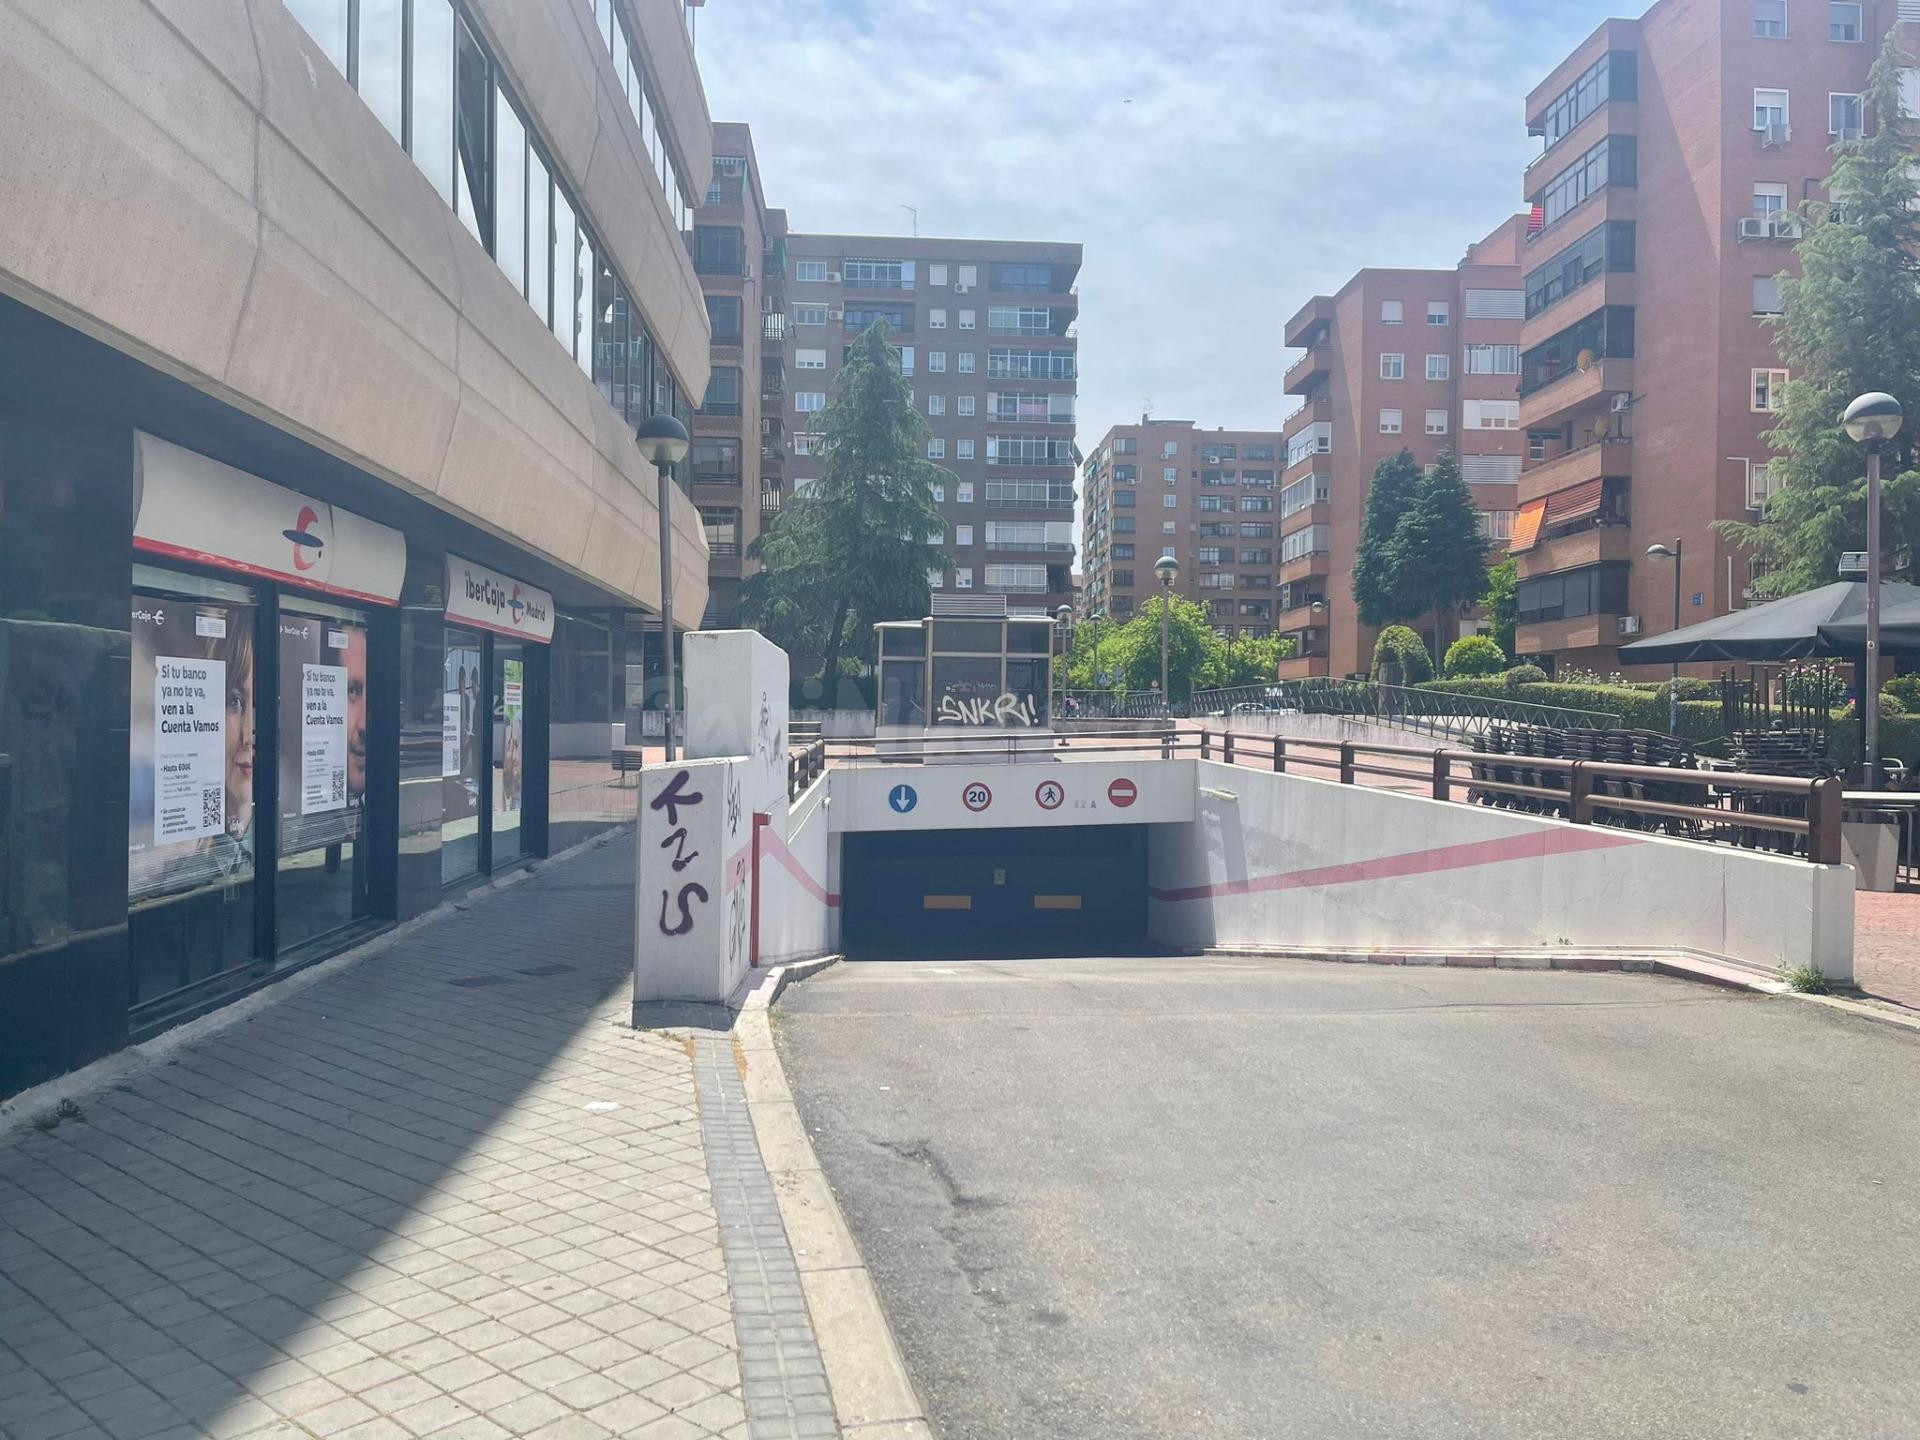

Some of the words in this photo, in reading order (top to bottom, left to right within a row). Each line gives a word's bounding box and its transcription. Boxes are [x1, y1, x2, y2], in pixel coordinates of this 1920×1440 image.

[464, 570, 505, 615] iberCaja
[526, 601, 546, 622] Madrid
[161, 664, 170, 679] Si
[171, 666, 181, 679] tu
[182, 666, 207, 680] banco
[306, 670, 312, 681] Si
[312, 671, 320, 682] tu
[319, 672, 336, 683] banco
[161, 686, 172, 700] ya
[173, 686, 184, 698] no
[185, 685, 193, 698] te
[161, 704, 177, 715] ven
[179, 705, 185, 715] a
[186, 702, 194, 715] la
[306, 702, 317, 711] ven
[305, 714, 326, 726] Cuenta
[325, 715, 344, 726] Vamos
[161, 720, 192, 734] Cuenta
[193, 720, 219, 733] Vamos
[968, 790, 987, 803] 20
